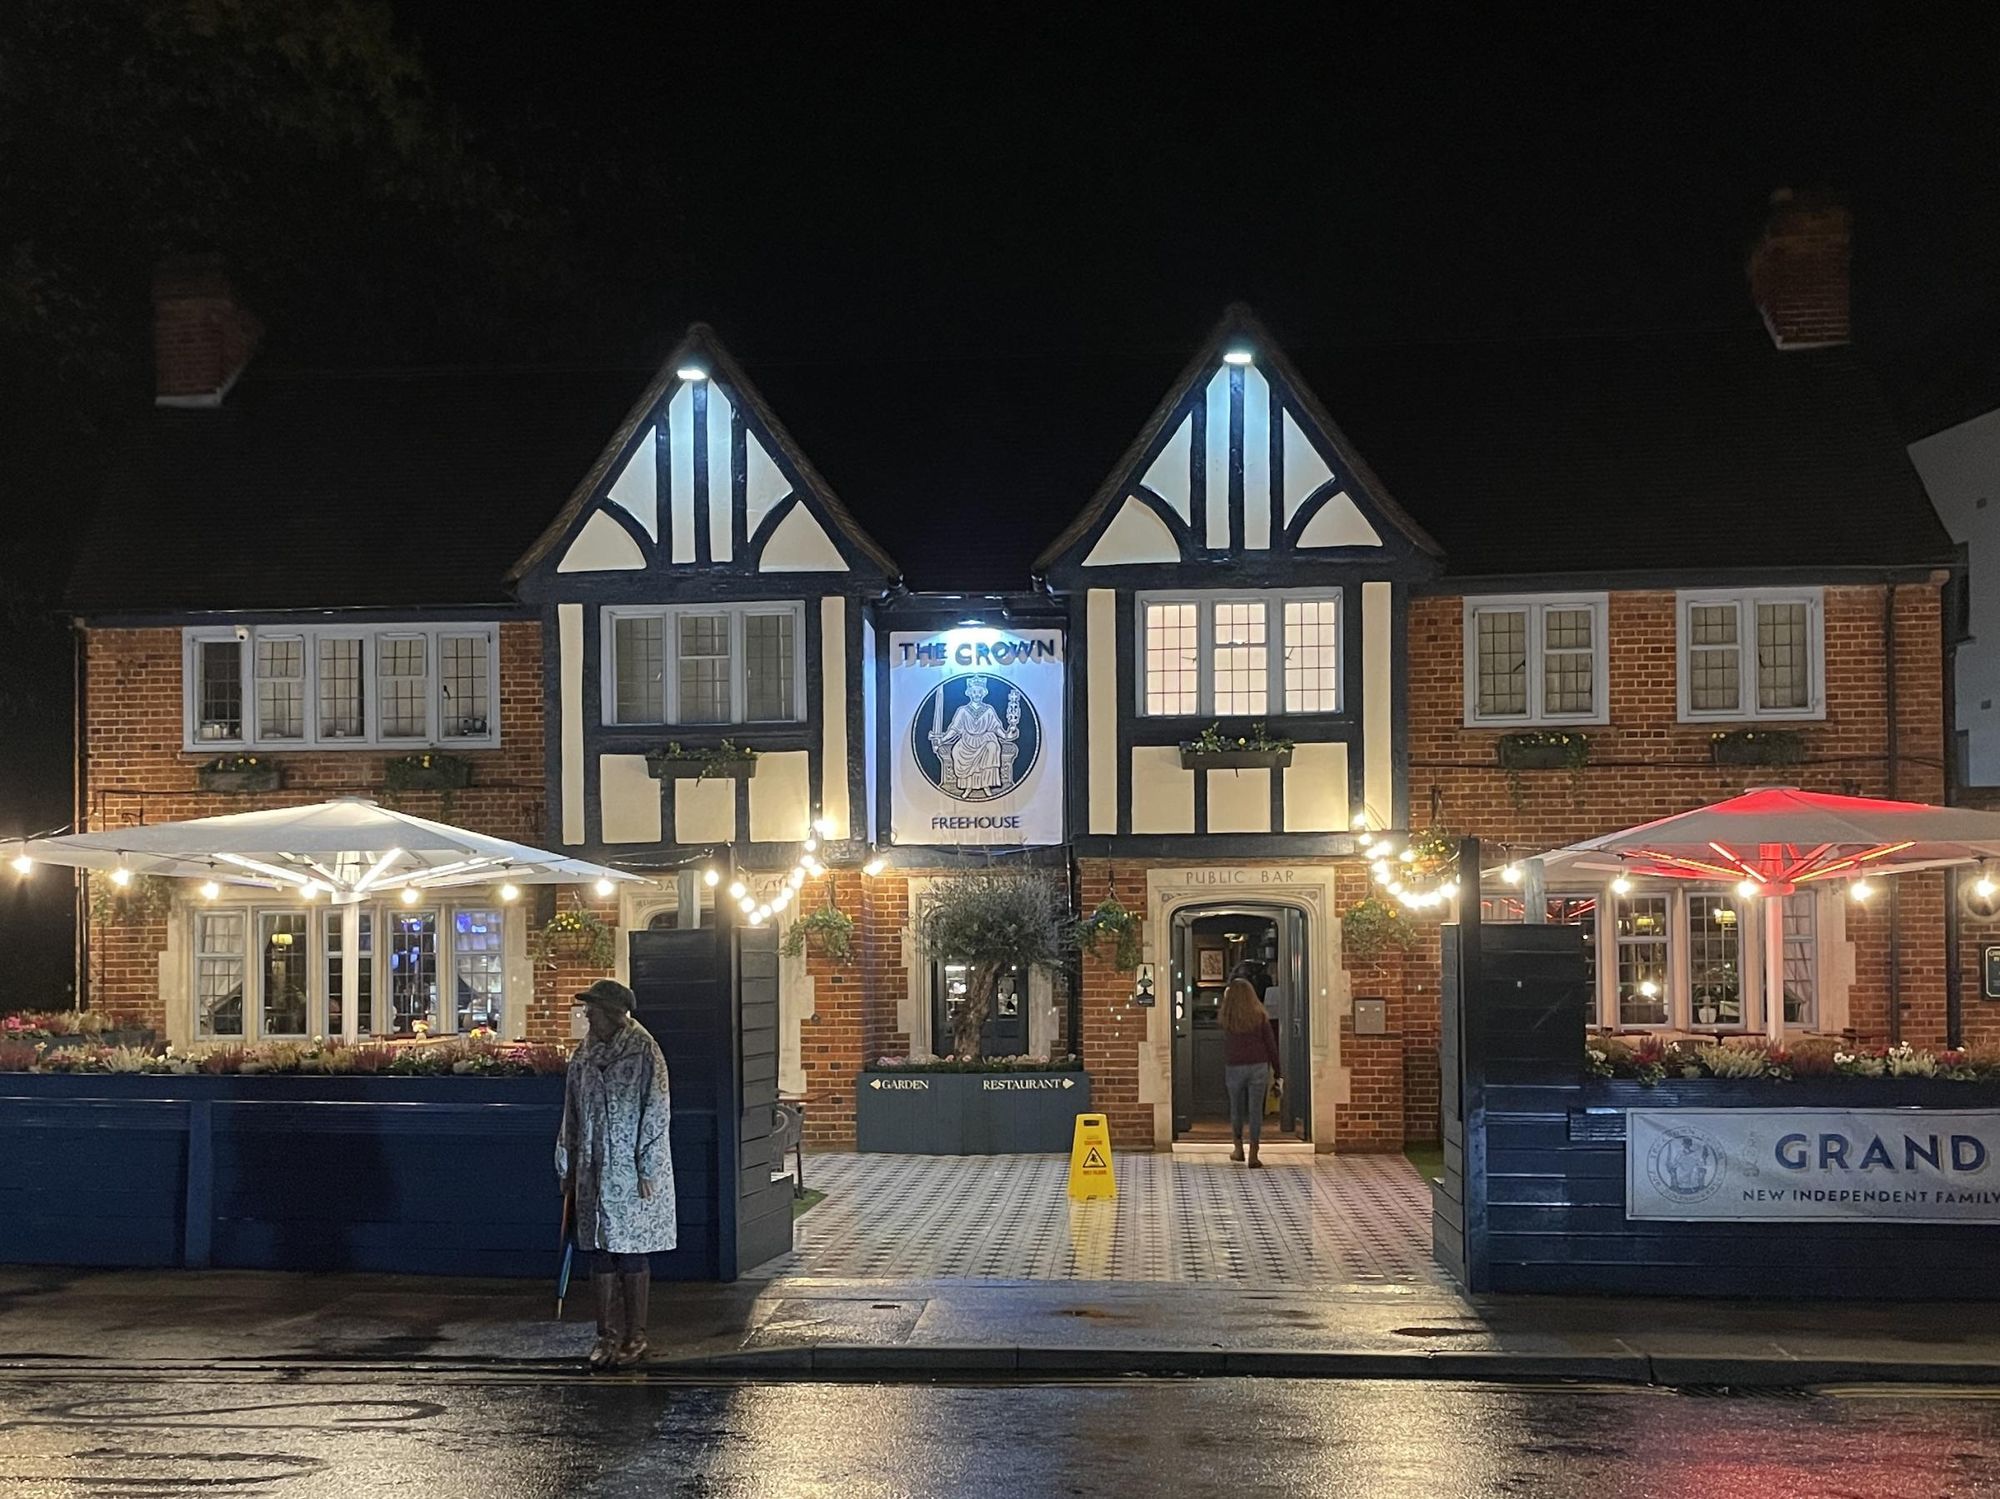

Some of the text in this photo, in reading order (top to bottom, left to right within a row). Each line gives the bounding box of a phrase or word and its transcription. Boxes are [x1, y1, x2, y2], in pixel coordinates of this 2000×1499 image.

[898, 639, 1055, 665] THE CROWN
[932, 816, 1019, 830] FREEHOUSE
[1186, 870, 1294, 884] PUBLIC BAR
[881, 1079, 929, 1090] GARDEN
[983, 1078, 1062, 1090] RESTAURANT
[1775, 1134, 1985, 1171] GRAND
[1743, 1189, 2000, 1204] NEW INDEPENDENT FAMILY
